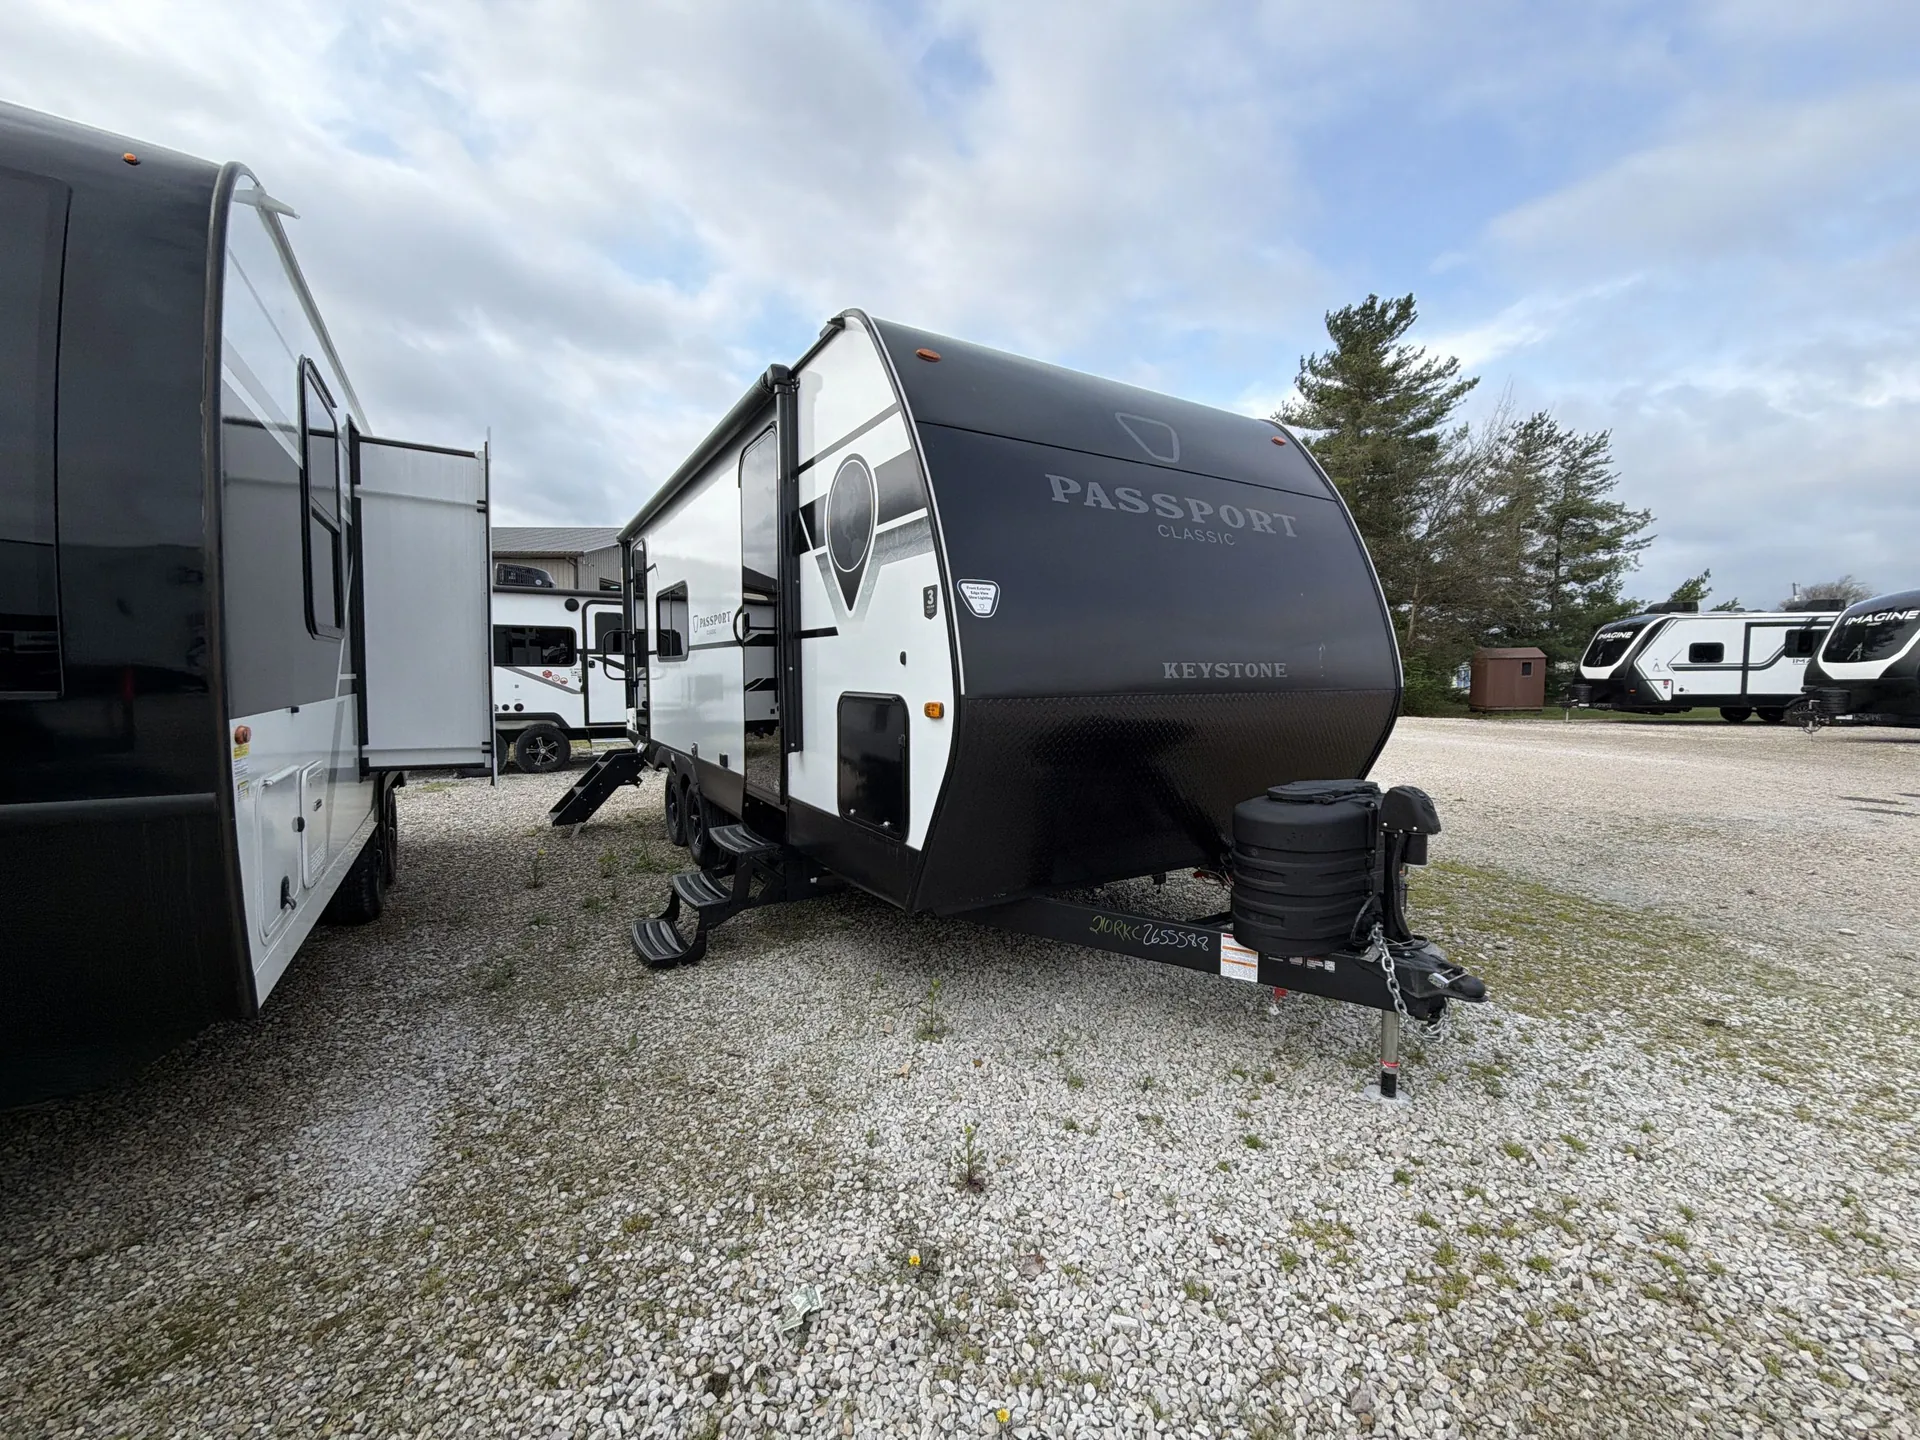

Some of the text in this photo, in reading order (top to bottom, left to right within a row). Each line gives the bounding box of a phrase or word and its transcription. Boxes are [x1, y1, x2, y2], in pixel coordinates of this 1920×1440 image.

[1045, 473, 1298, 538] PASSPORT
[1157, 524, 1236, 546] CLASSIC
[927, 589, 934, 605] 3
[700, 611, 731, 628] PASSPORT
[1844, 609, 1920, 626] IMAGINE
[1596, 631, 1634, 640] IMAGINE
[1162, 662, 1288, 679] KEYSTONE
[1142, 923, 1209, 952] 2655588
